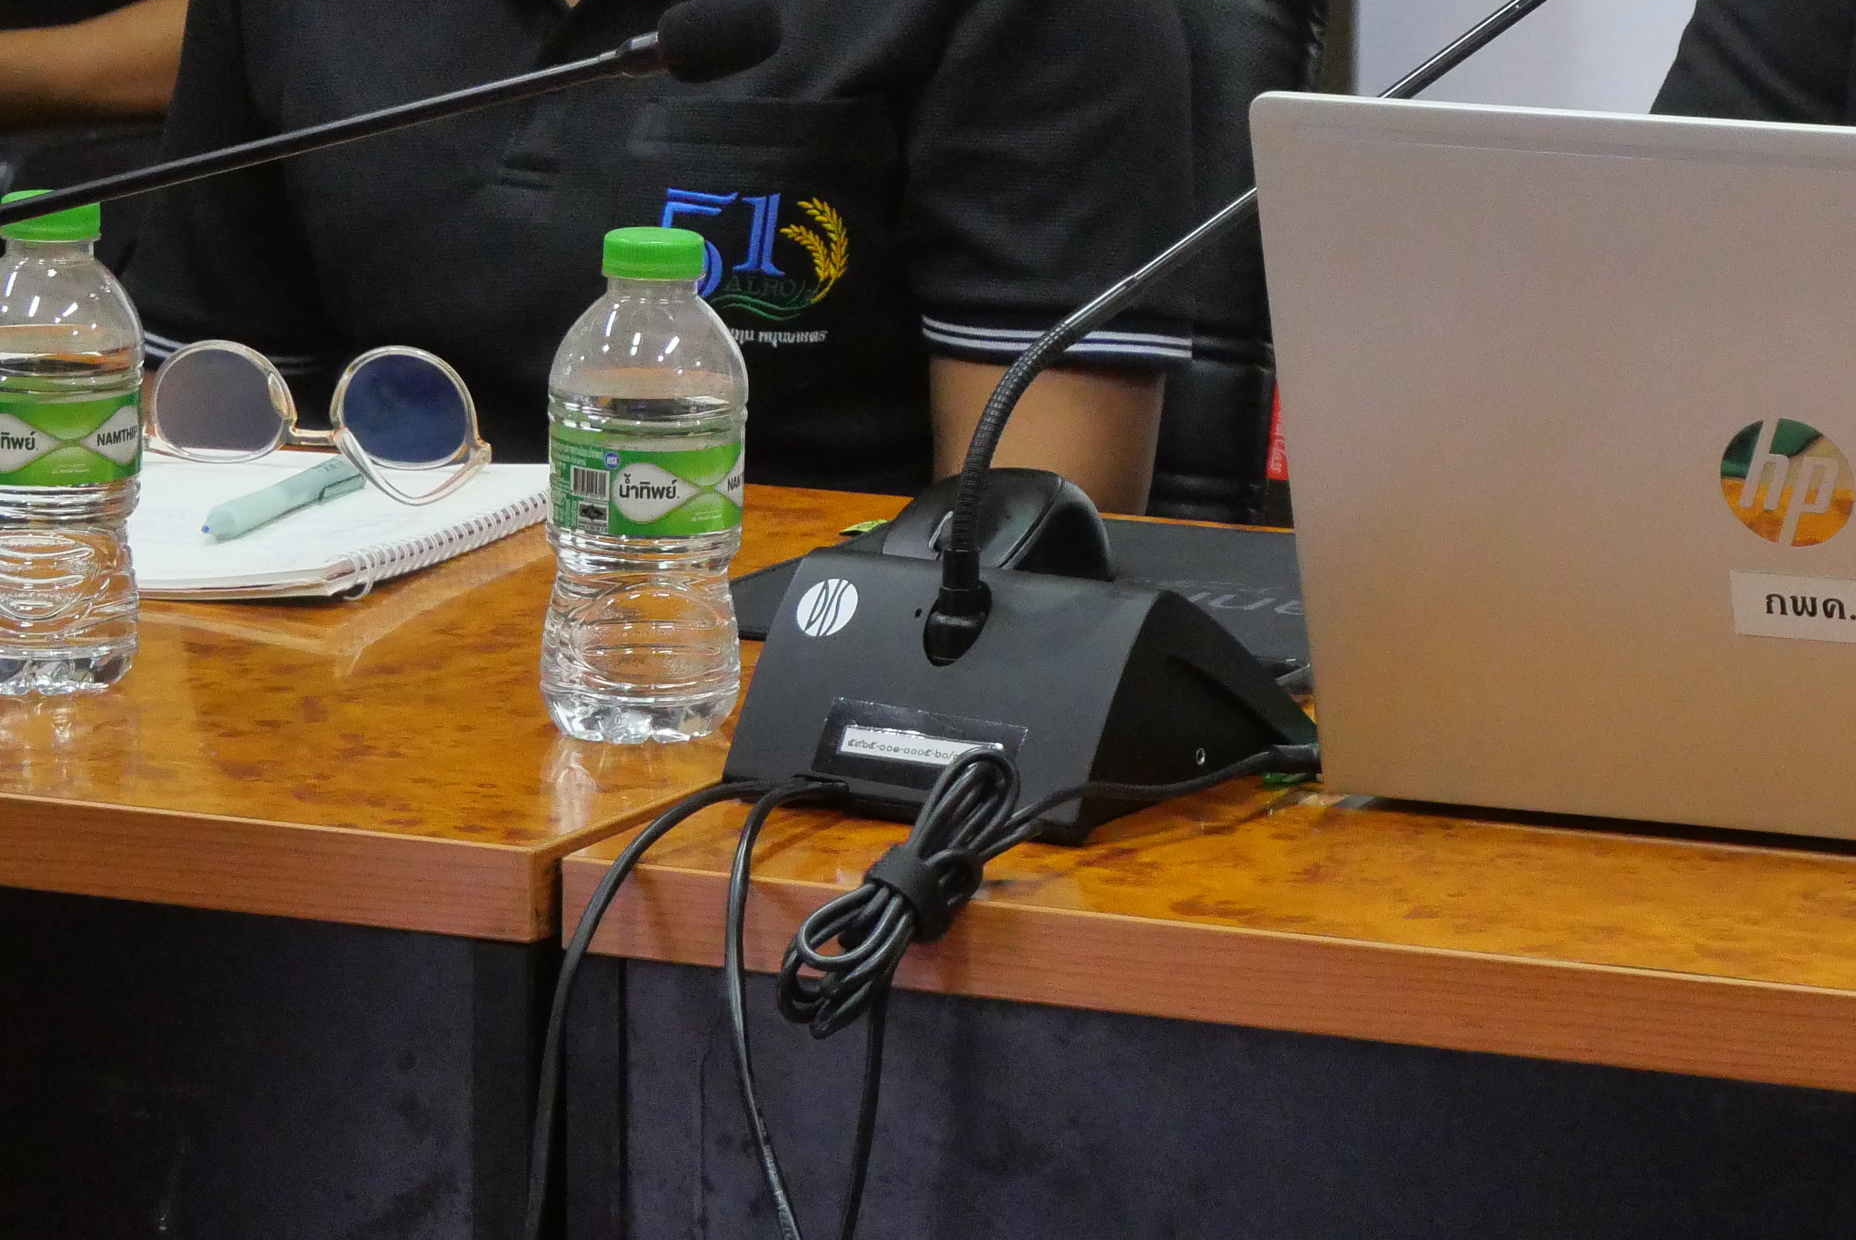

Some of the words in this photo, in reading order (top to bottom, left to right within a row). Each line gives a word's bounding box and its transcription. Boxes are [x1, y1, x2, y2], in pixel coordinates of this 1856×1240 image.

[618, 472, 679, 500] น้ำทิพย์
[1733, 417, 1843, 548] hp
